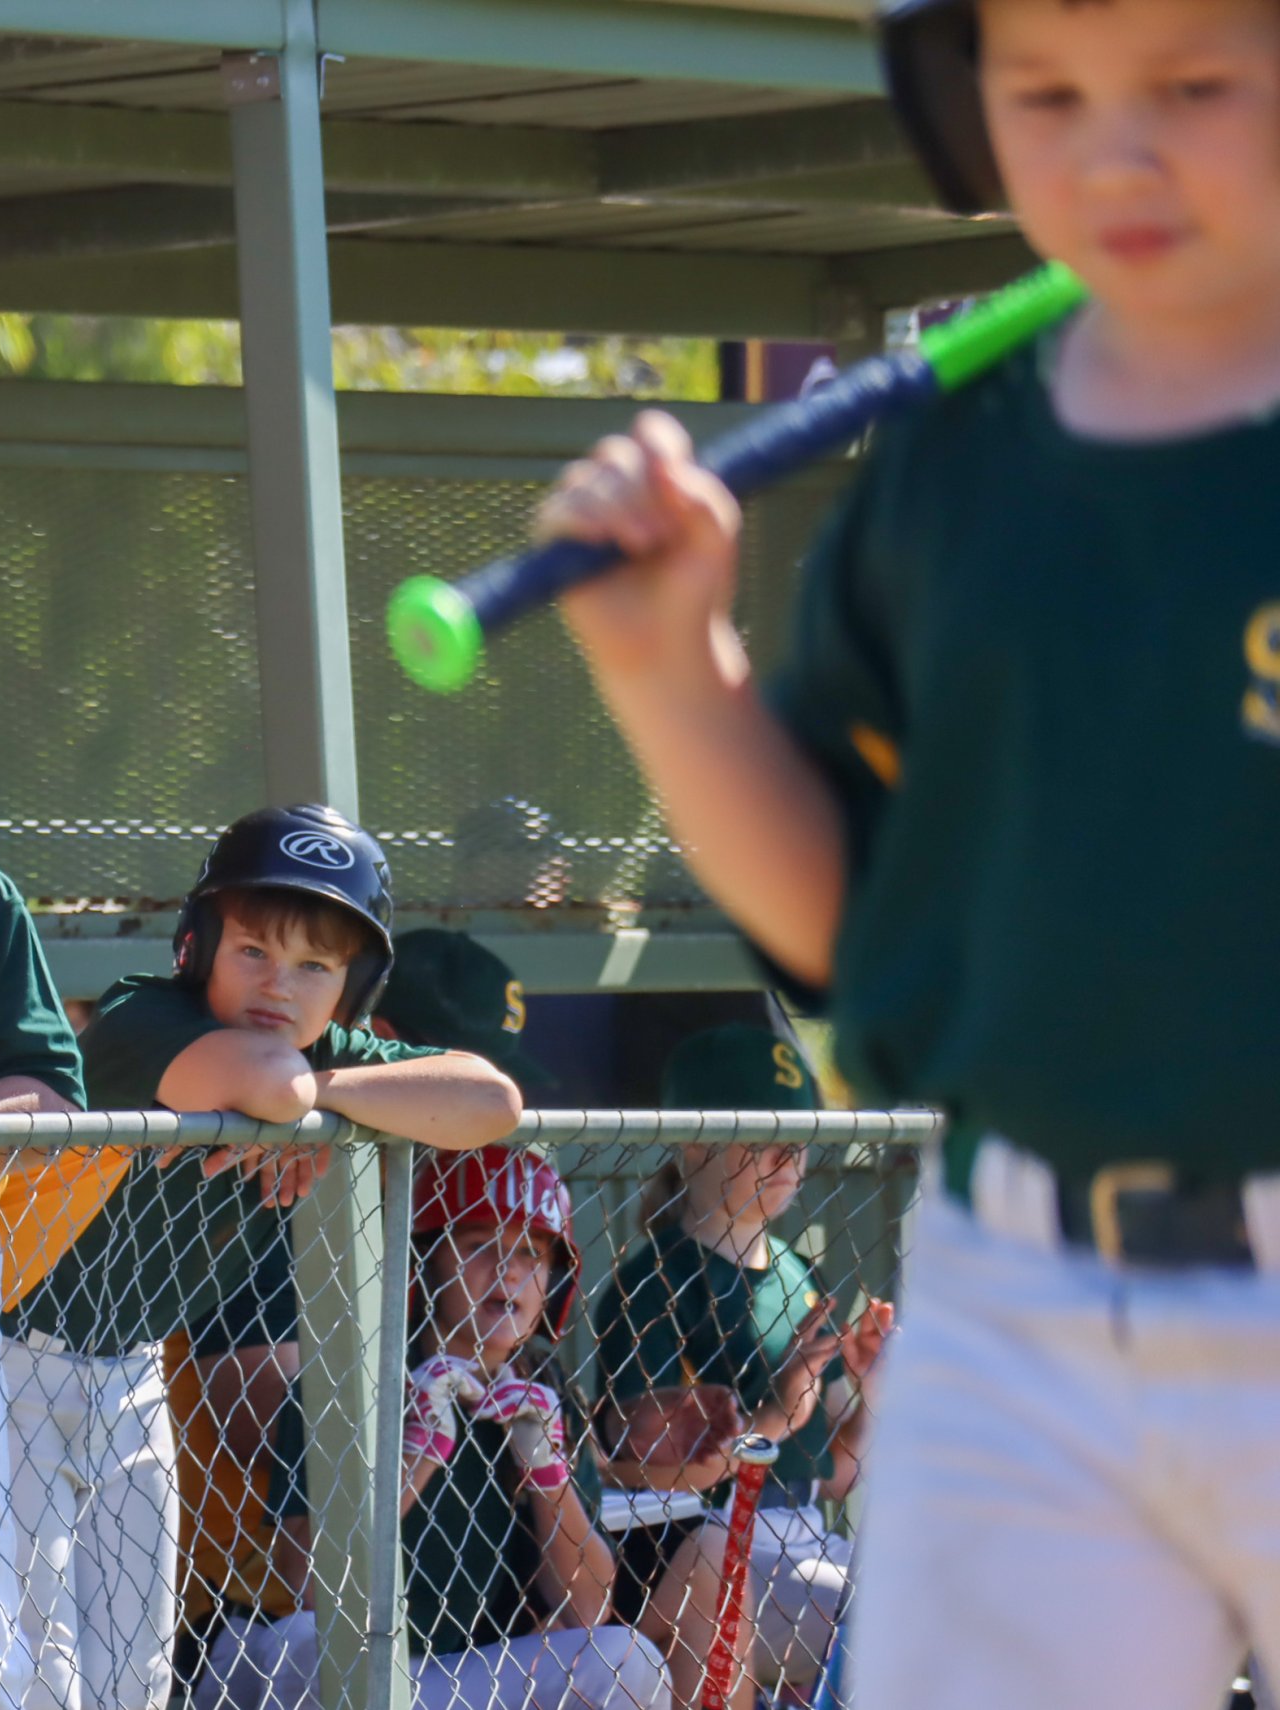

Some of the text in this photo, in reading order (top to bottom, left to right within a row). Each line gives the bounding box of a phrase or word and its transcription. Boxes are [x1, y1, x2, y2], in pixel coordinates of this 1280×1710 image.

[287, 834, 341, 866] R
[501, 980, 526, 1034] S
[771, 1042, 803, 1090] S
